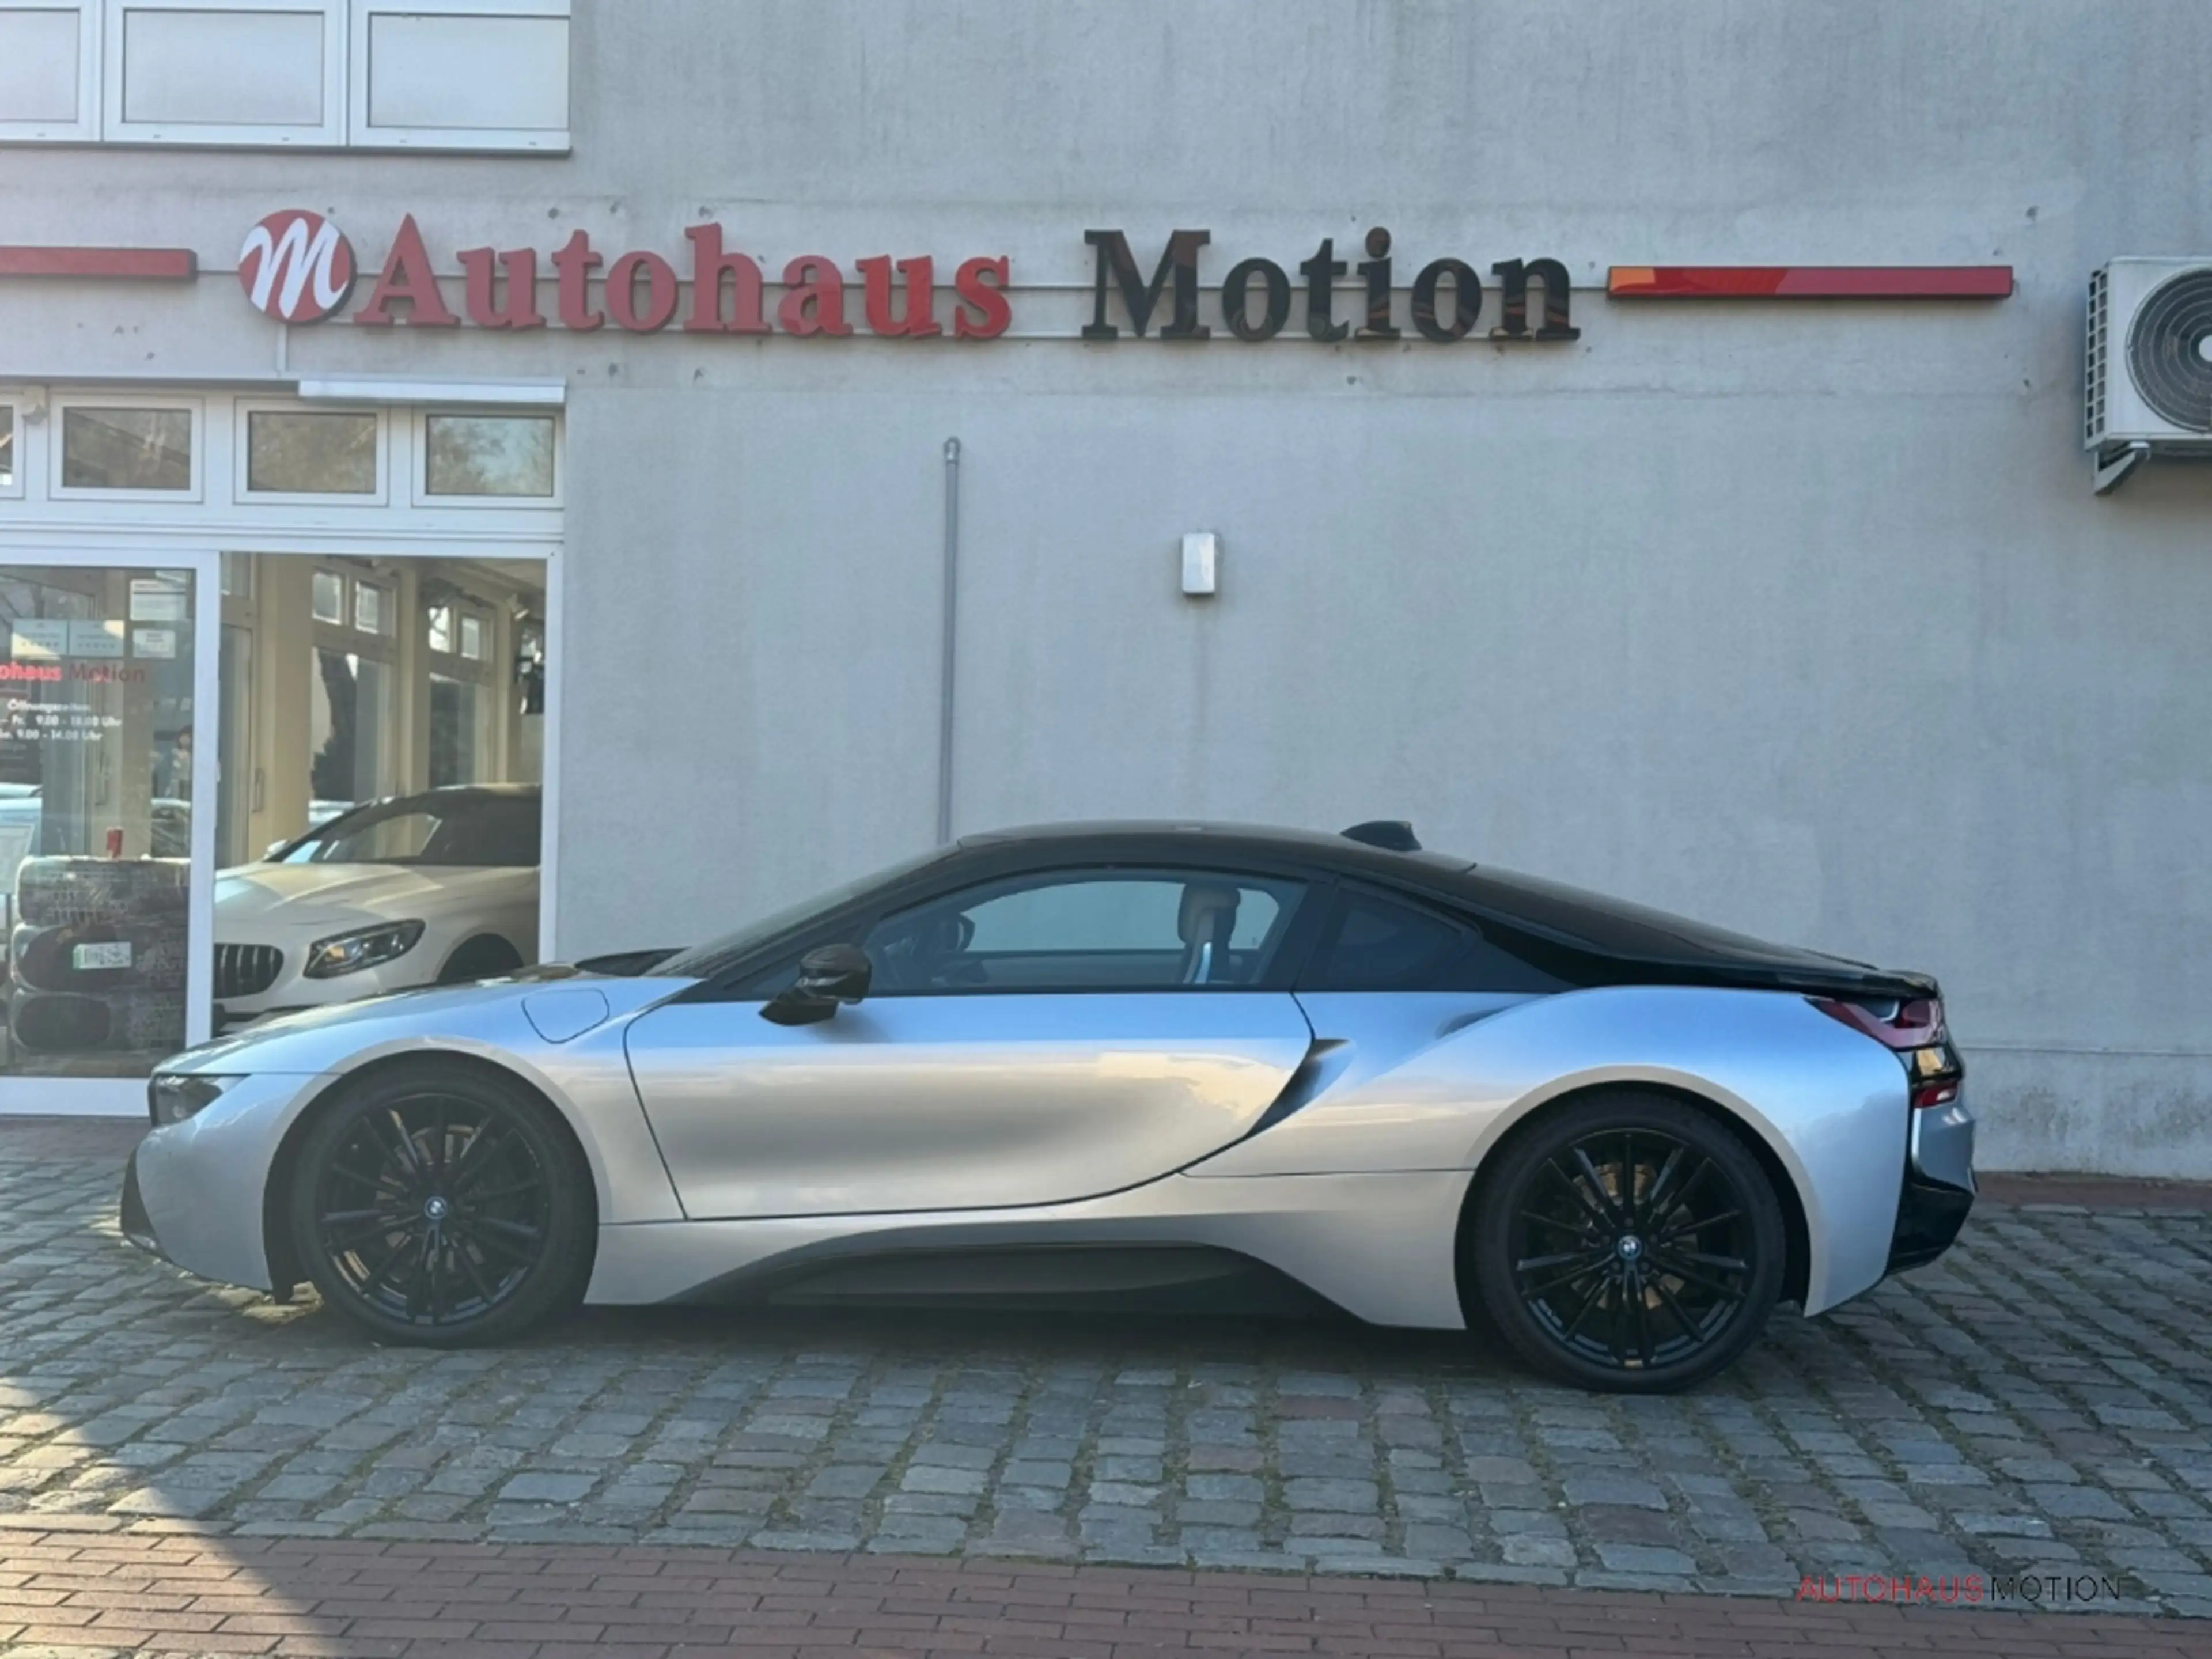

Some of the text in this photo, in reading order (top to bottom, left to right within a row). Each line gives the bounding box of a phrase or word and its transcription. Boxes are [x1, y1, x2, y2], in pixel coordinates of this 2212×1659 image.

[352, 212, 1013, 339] Autohaus
[1081, 226, 1581, 342] Motion
[69, 664, 145, 683] Motion
